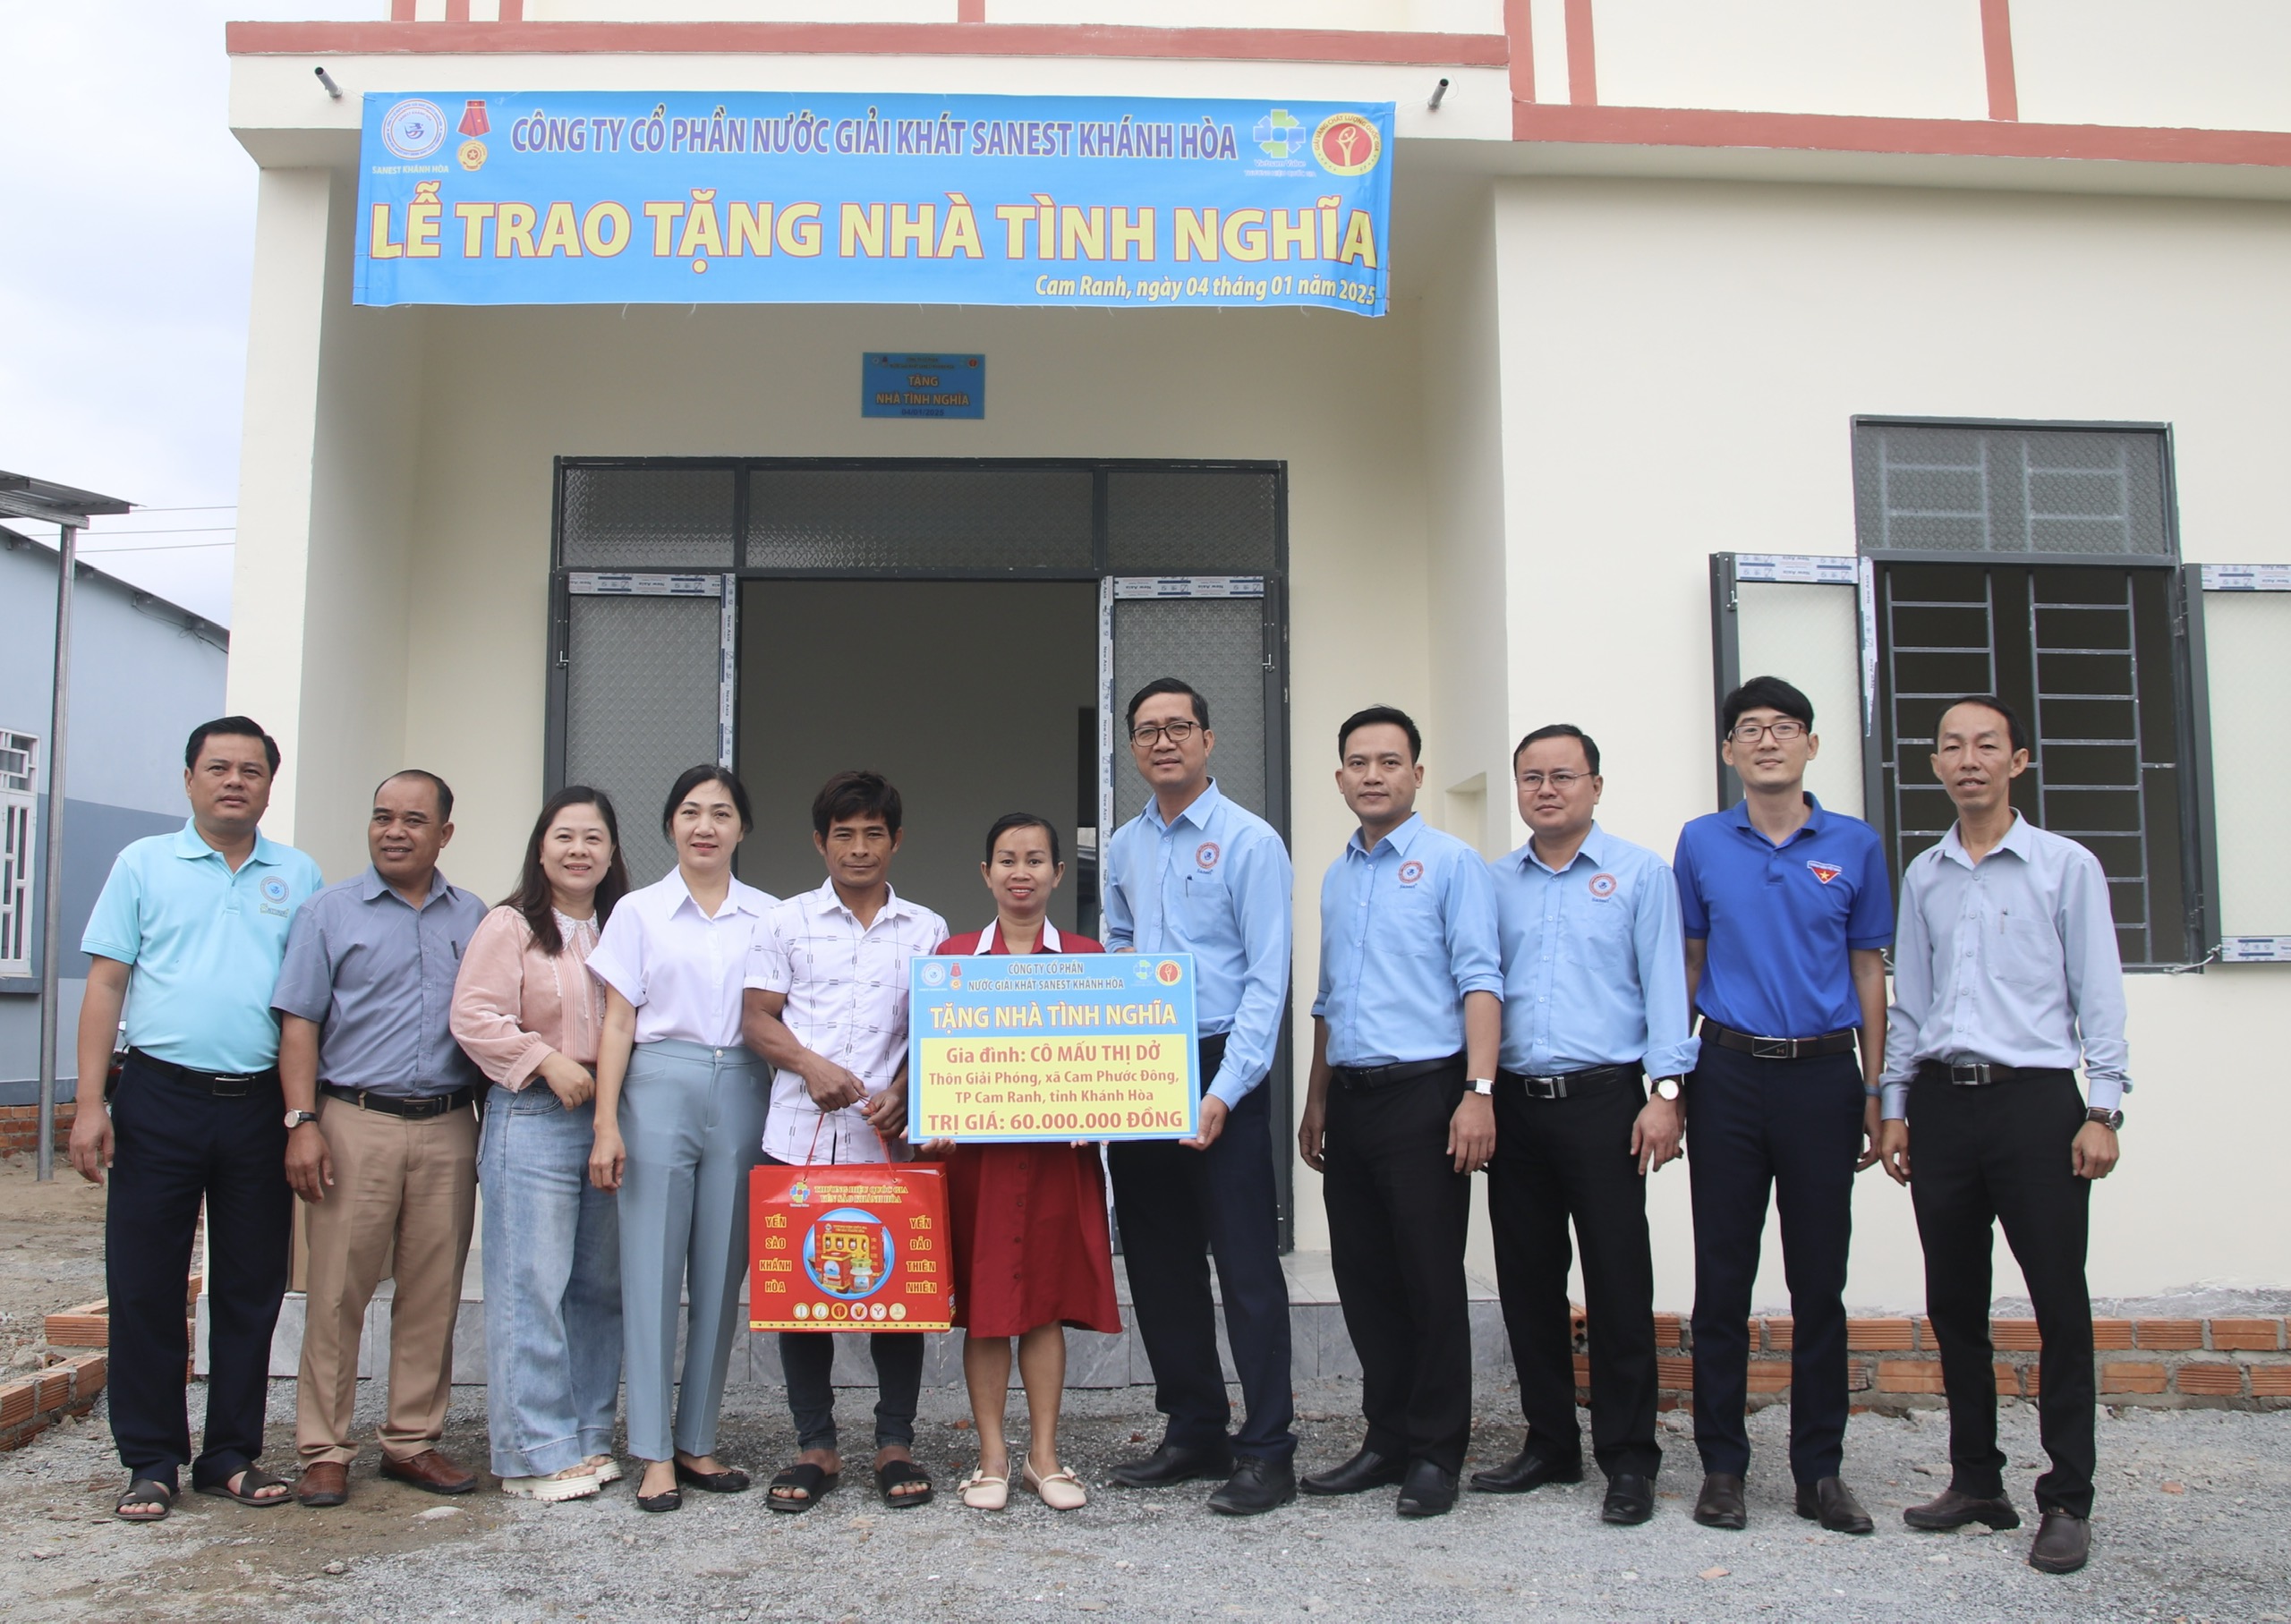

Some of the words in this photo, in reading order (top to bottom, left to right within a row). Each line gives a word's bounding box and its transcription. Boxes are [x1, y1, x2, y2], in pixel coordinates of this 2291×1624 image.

[512, 109, 586, 152] CÔNG
[591, 117, 626, 152] TY
[629, 103, 666, 152] CỔ
[670, 106, 746, 152] PHẦN
[752, 109, 830, 153] NƯỚC
[834, 106, 890, 154] GIẢI
[895, 112, 967, 155] KHÁT
[971, 120, 1073, 157] SANEST
[1078, 115, 1173, 158] KHÁNH
[1180, 116, 1238, 159] HÒA
[371, 166, 401, 174] SANEST
[403, 165, 430, 174] KHÁNH
[431, 165, 449, 173] HÒA
[370, 180, 442, 259] LỄ
[455, 200, 632, 259] TRAO
[643, 188, 822, 275] TẶNG
[839, 191, 984, 259] NHÀ
[996, 192, 1155, 262] TÌNH
[1173, 195, 1378, 269] NGHĨA
[1035, 274, 1076, 296] Cam
[1079, 274, 1133, 300] Ranh,
[1136, 276, 1183, 302] ngày
[1185, 276, 1209, 296] 04
[1213, 275, 1267, 302] tháng
[1271, 275, 1292, 296] 01
[1298, 274, 1337, 297] năm
[1338, 279, 1375, 306] 2025
[908, 374, 939, 388] TẶNG
[876, 392, 900, 404] NHÀ
[903, 392, 930, 405] TÌNH
[933, 392, 969, 405] NGHĨA
[1008, 962, 1032, 974] CÔNG
[1035, 964, 1045, 974] TY
[1046, 960, 1059, 974] CỔ
[1060, 960, 1084, 974] PHẦN
[968, 979, 993, 991] NƯỚC
[995, 978, 1013, 991] GIẢI
[1015, 977, 1037, 991] KHÁT
[1039, 979, 1071, 991] SANEST
[1073, 976, 1103, 991] KHÁNH
[1105, 977, 1124, 990] HÒA
[930, 1001, 990, 1034] TẶNG
[994, 1000, 1043, 1028] NHÀ
[1046, 1000, 1100, 1027] TÌNH
[1105, 999, 1178, 1025] NGHĨA
[946, 1047, 975, 1063] Gia
[979, 1046, 1026, 1063] đình:
[1030, 1043, 1052, 1062] CÔ
[1058, 1041, 1096, 1062] MẤU
[1101, 1044, 1130, 1065] THỊ
[1137, 1040, 1161, 1061] DỞ
[929, 1073, 962, 1085] Thôn
[966, 1072, 991, 1084] Giải
[995, 1071, 1042, 1087] Phóng,
[1045, 1071, 1060, 1084] xã
[1064, 1071, 1093, 1083] Cam
[1096, 1070, 1137, 1082] Phước
[1140, 1069, 1179, 1084] Đông,
[955, 1092, 971, 1103] TP
[975, 1092, 1003, 1103] Cam
[1008, 1091, 1046, 1104] Ranh,
[1050, 1090, 1077, 1102] tỉnh
[1081, 1089, 1124, 1101] Khánh
[1128, 1088, 1154, 1101] Hòa
[928, 1114, 958, 1135] TRỊ
[965, 1110, 1005, 1130] GIÁ:
[1009, 1112, 1121, 1130] 60.000.000
[1126, 1107, 1182, 1128] ĐỒNG
[765, 1213, 787, 1229] YẾN
[909, 1215, 932, 1229] YẾN
[765, 1236, 787, 1250] SÀO
[909, 1236, 932, 1251] ĐẢO
[759, 1258, 792, 1271] KHÁNH
[906, 1259, 936, 1272] THIÊN
[765, 1280, 786, 1293] HÒA
[906, 1280, 937, 1294] NHIÊN
